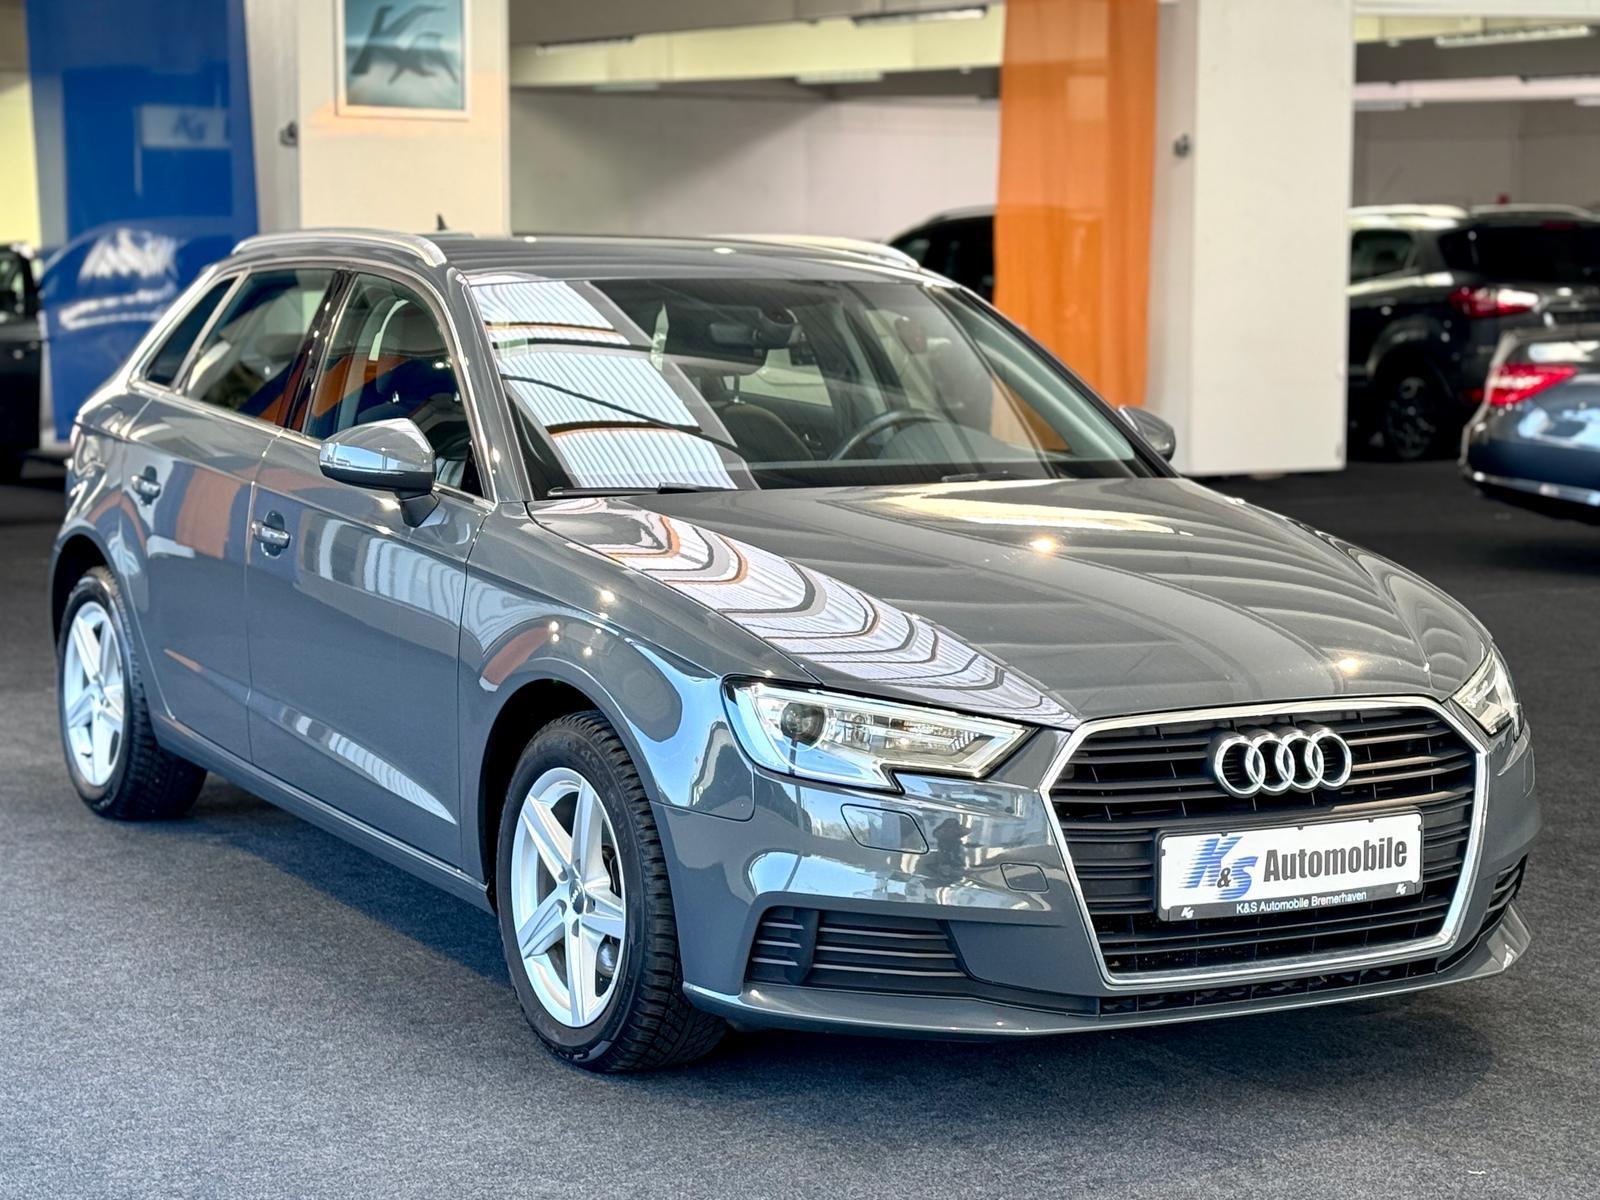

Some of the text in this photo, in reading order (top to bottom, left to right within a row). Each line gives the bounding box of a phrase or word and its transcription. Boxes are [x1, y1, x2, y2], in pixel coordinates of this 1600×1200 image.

[1263, 836, 1408, 883] Automobile
[1236, 891, 1367, 914] K&S Automobile Bremerhaven
